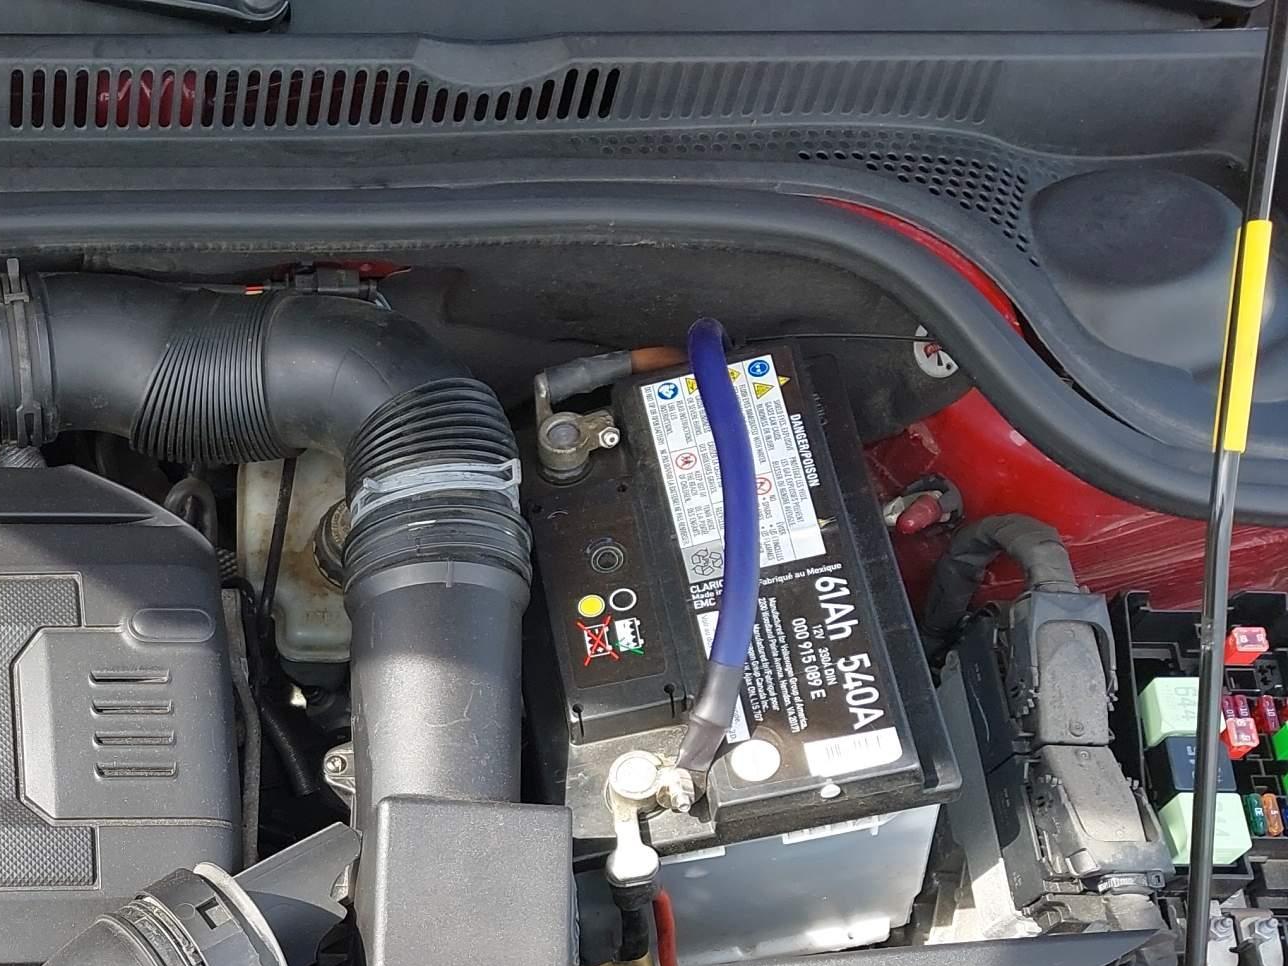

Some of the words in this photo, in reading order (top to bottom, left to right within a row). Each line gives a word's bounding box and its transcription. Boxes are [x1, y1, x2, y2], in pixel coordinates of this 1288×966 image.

[790, 413, 821, 487] DANGER/POISON
[807, 563, 842, 576] Mexique
[691, 591, 715, 601] Made
[693, 598, 717, 610] EMC
[811, 573, 863, 641] 61Ah
[767, 596, 784, 635] Manufactured
[788, 616, 811, 640] 000
[810, 623, 825, 640] 12V
[779, 643, 796, 677] Volkswagen
[795, 640, 817, 664] 915
[816, 646, 833, 668] 330A
[787, 677, 801, 695] Group
[802, 664, 824, 688] 089
[822, 667, 838, 686] DIN
[753, 677, 769, 700] Canada
[792, 695, 803, 703] of
[808, 688, 827, 700] E
[834, 651, 888, 730] 540A
[768, 695, 781, 712] pour
